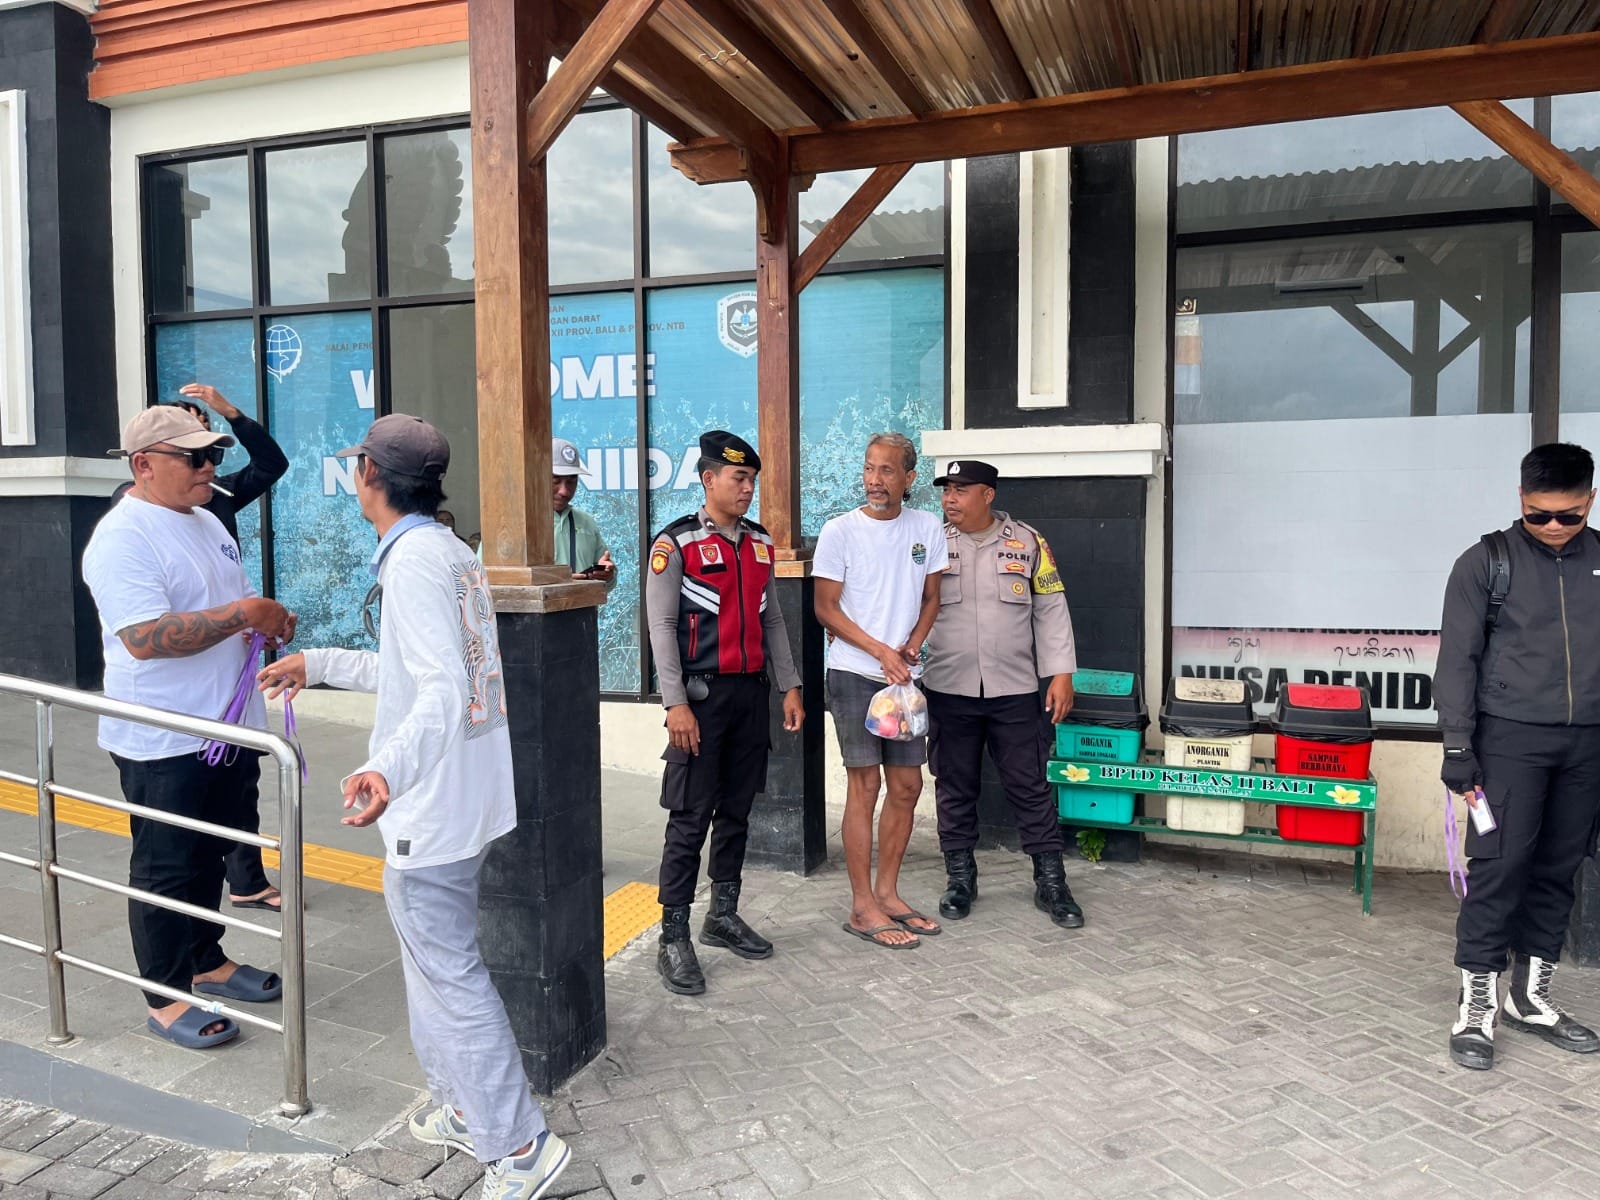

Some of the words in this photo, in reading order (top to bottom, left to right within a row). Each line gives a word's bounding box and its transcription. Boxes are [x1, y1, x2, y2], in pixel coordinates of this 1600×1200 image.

[571, 314, 601, 324] DARAT
[566, 327, 593, 336] PROV.
[595, 325, 616, 334] BALI
[618, 324, 626, 333] &
[628, 322, 665, 333] POV.
[667, 321, 686, 331] NTB
[998, 551, 1030, 562] POLRI
[1080, 737, 1113, 748] ORGANIK
[1186, 744, 1229, 757] ANORGANIK
[1099, 765, 1156, 781] BPTD
[1160, 770, 1233, 788] KELAS
[1261, 777, 1315, 796] BALI
